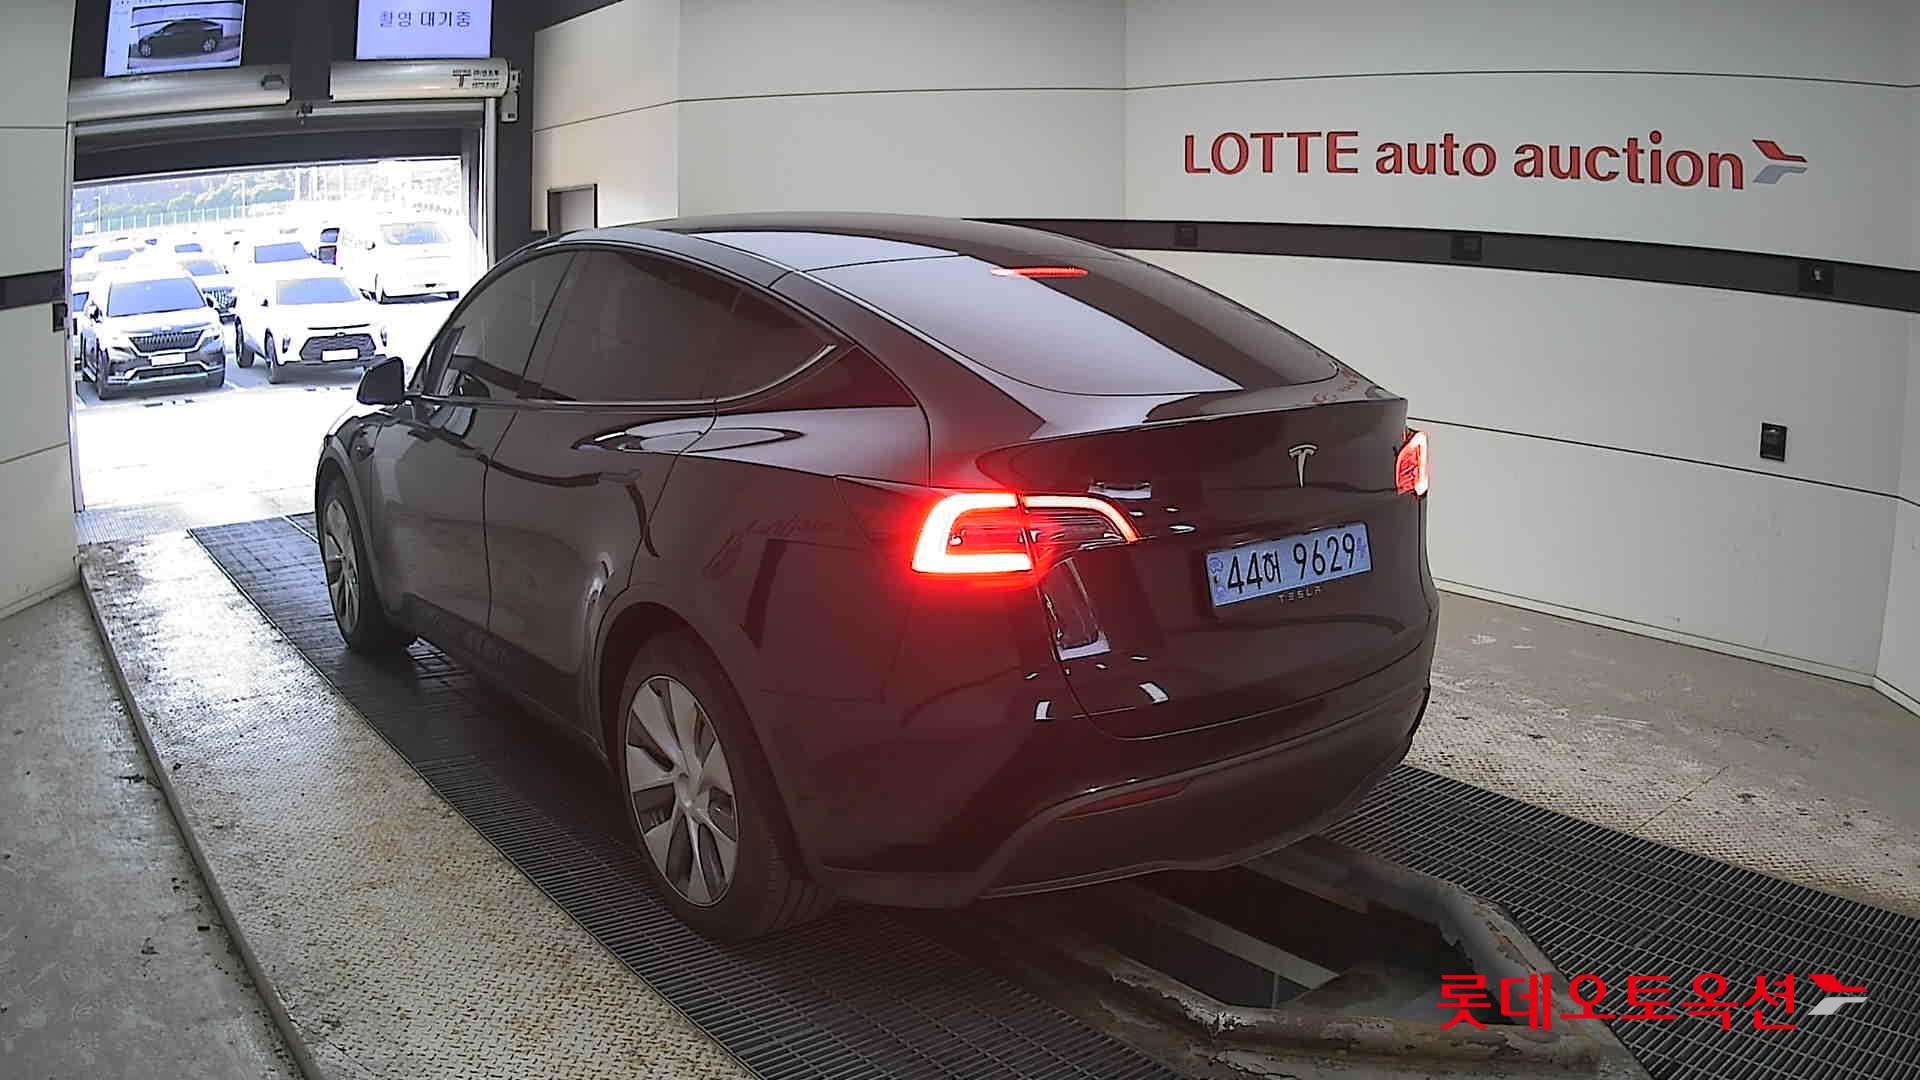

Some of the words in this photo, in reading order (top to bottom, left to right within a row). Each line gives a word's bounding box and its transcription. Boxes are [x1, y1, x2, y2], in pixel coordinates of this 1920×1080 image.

[420, 11, 471, 28] 대기중
[1184, 131, 1359, 174] LOTTE
[1376, 133, 1497, 176] auto
[1513, 130, 1744, 189] auction
[1227, 551, 1282, 594] 44허
[1293, 532, 1355, 580] 9629
[1278, 585, 1321, 604] TESLA
